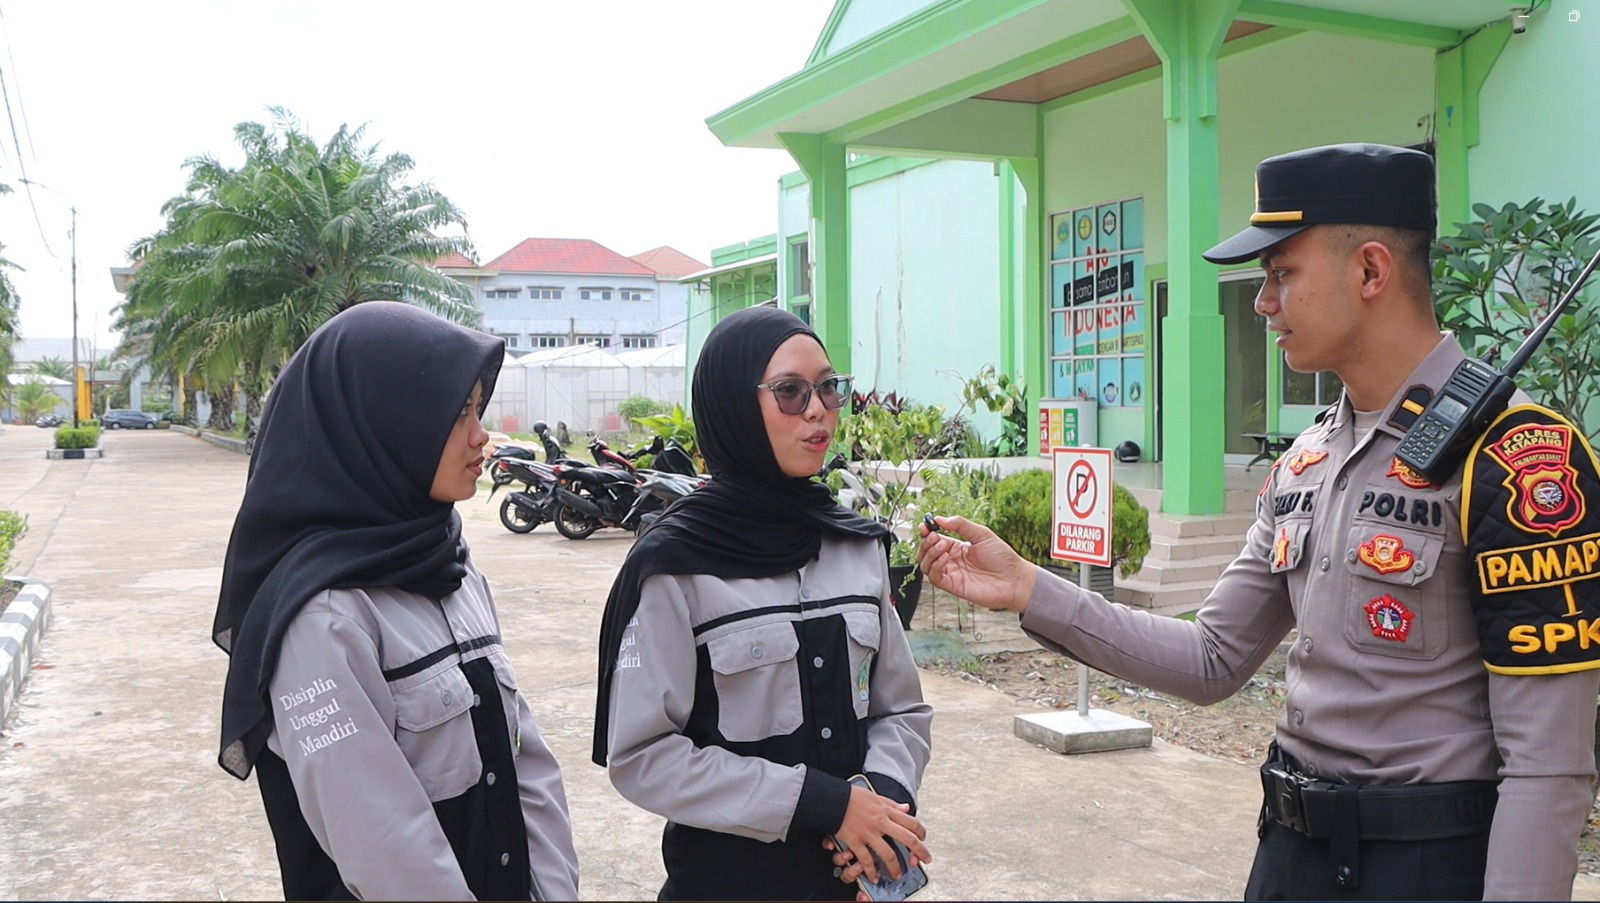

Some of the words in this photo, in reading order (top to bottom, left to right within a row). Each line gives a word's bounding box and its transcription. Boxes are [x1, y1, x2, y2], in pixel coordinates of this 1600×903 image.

[1502, 429, 1560, 449] POLRES
[1504, 437, 1562, 456] KETAPANG
[1359, 491, 1441, 527] POLRI
[1060, 524, 1102, 541] DILARANG
[1065, 537, 1096, 553] PARKIR
[1486, 540, 1600, 587] PAMAP
[279, 678, 337, 711] Disiplin
[289, 698, 341, 731] Unggul
[298, 716, 359, 757] Mandiri
